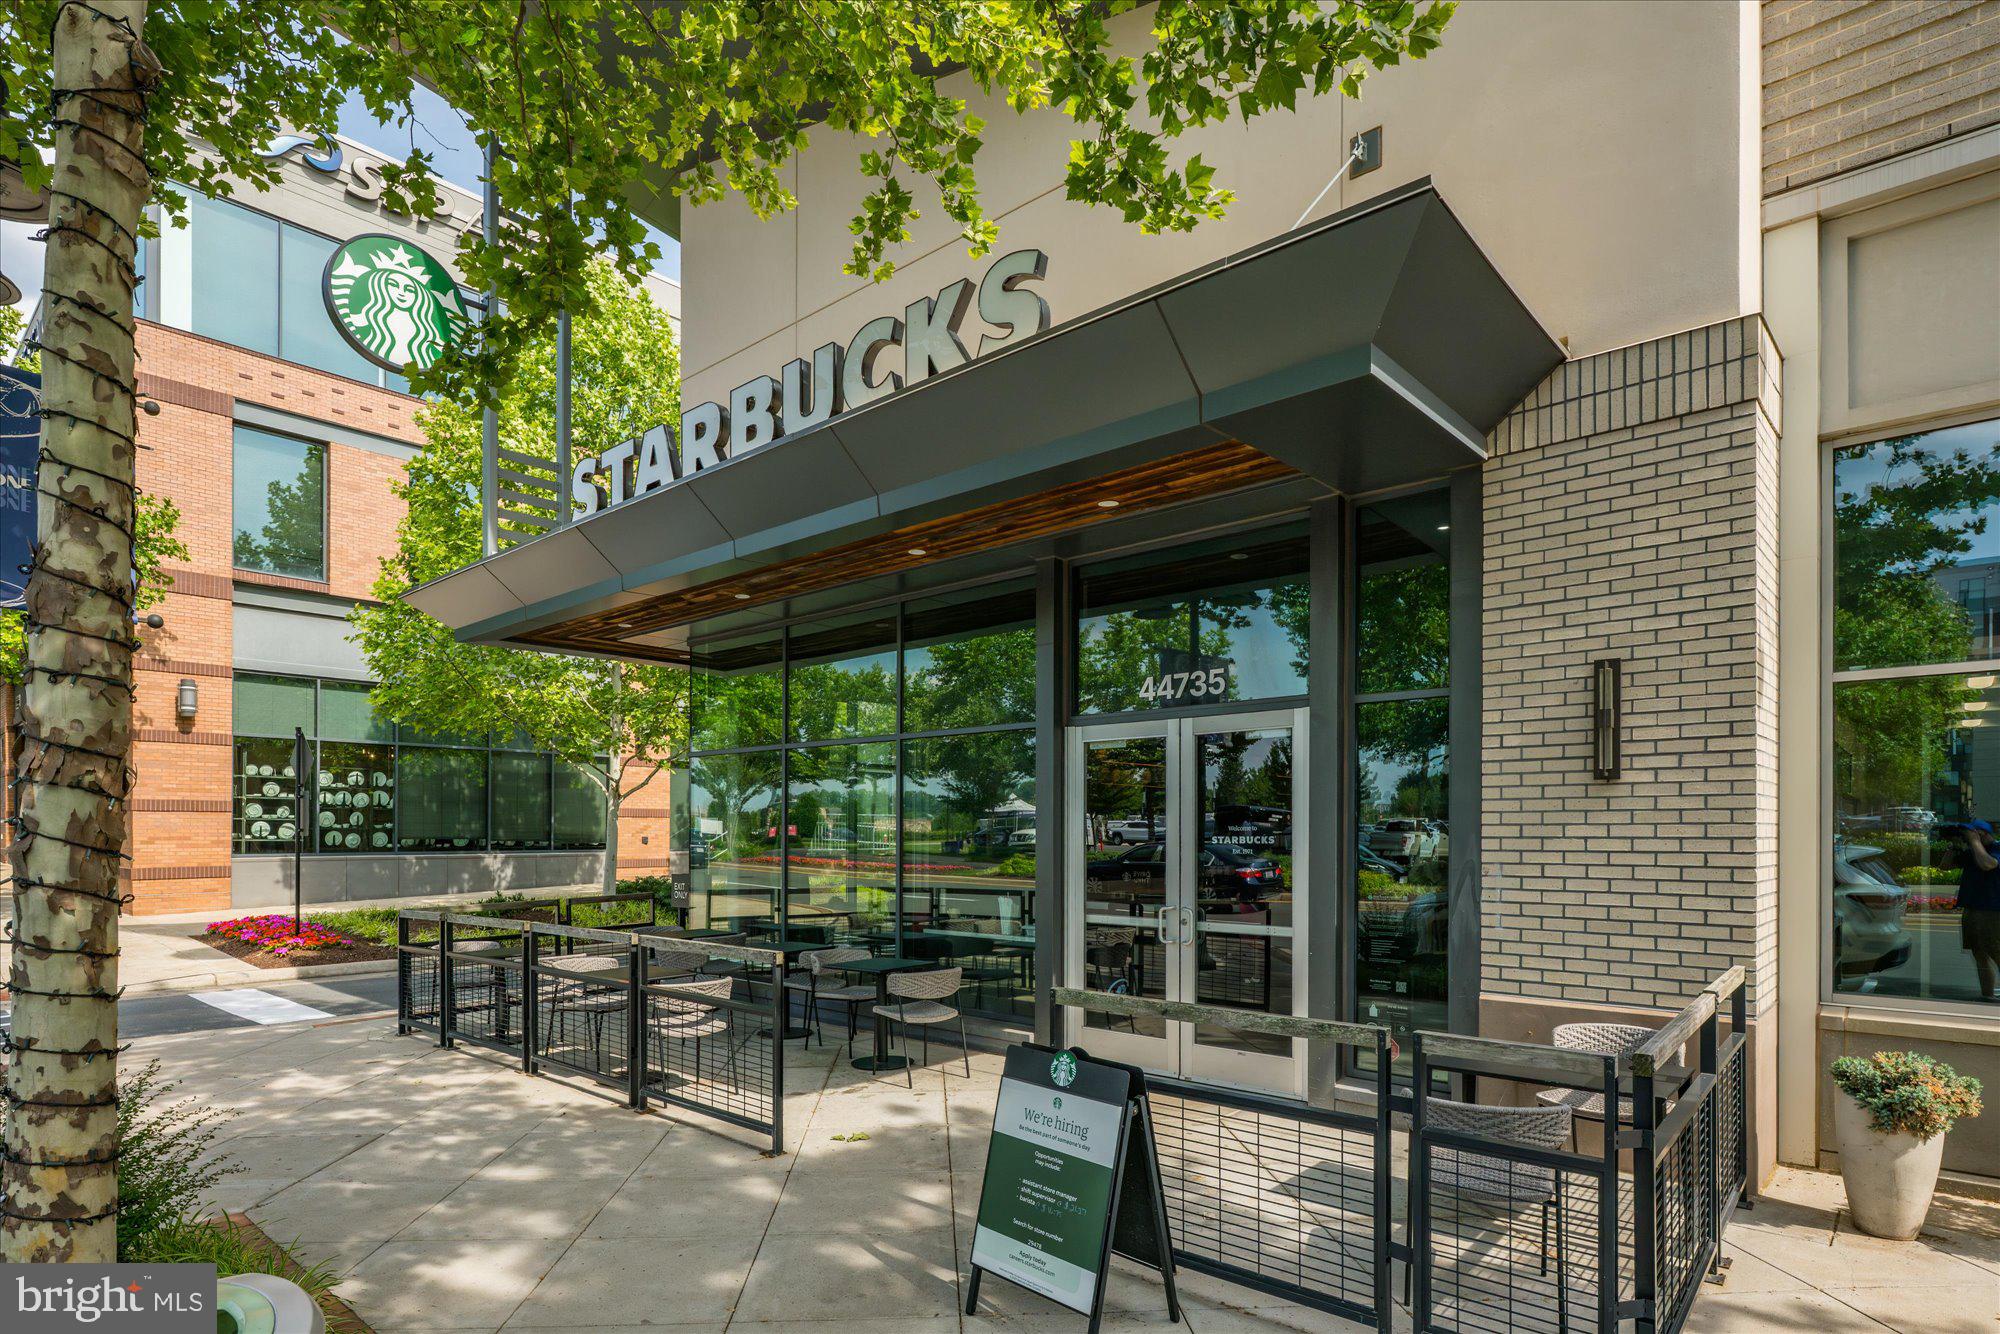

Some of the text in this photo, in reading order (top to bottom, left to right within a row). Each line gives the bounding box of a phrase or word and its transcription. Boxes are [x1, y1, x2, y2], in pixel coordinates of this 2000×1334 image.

[570, 249, 1049, 523] STARBUCKS
[1139, 668, 1226, 701] 44735
[1211, 835, 1275, 844] STARBUCKS
[674, 882, 685, 890] EXIT
[674, 890, 689, 899] ONLY
[1054, 1115, 1089, 1141] hiring
[1018, 1123, 1025, 1131] Be
[1032, 1128, 1042, 1136] best
[1042, 1131, 1051, 1139] part
[1081, 1142, 1091, 1152] day
[1034, 1150, 1064, 1165] Opportunities
[1034, 1159, 1044, 1167] may
[1020, 1186, 1056, 1203] shift supervisor
[1022, 1178, 1078, 1202] assistant store manager
[1019, 1195, 1036, 1206] barista
[1012, 1217, 1027, 1228] Search
[1034, 1227, 1046, 1236] store
[1045, 1231, 1064, 1243] number
[1019, 1250, 1047, 1267] Apply today
